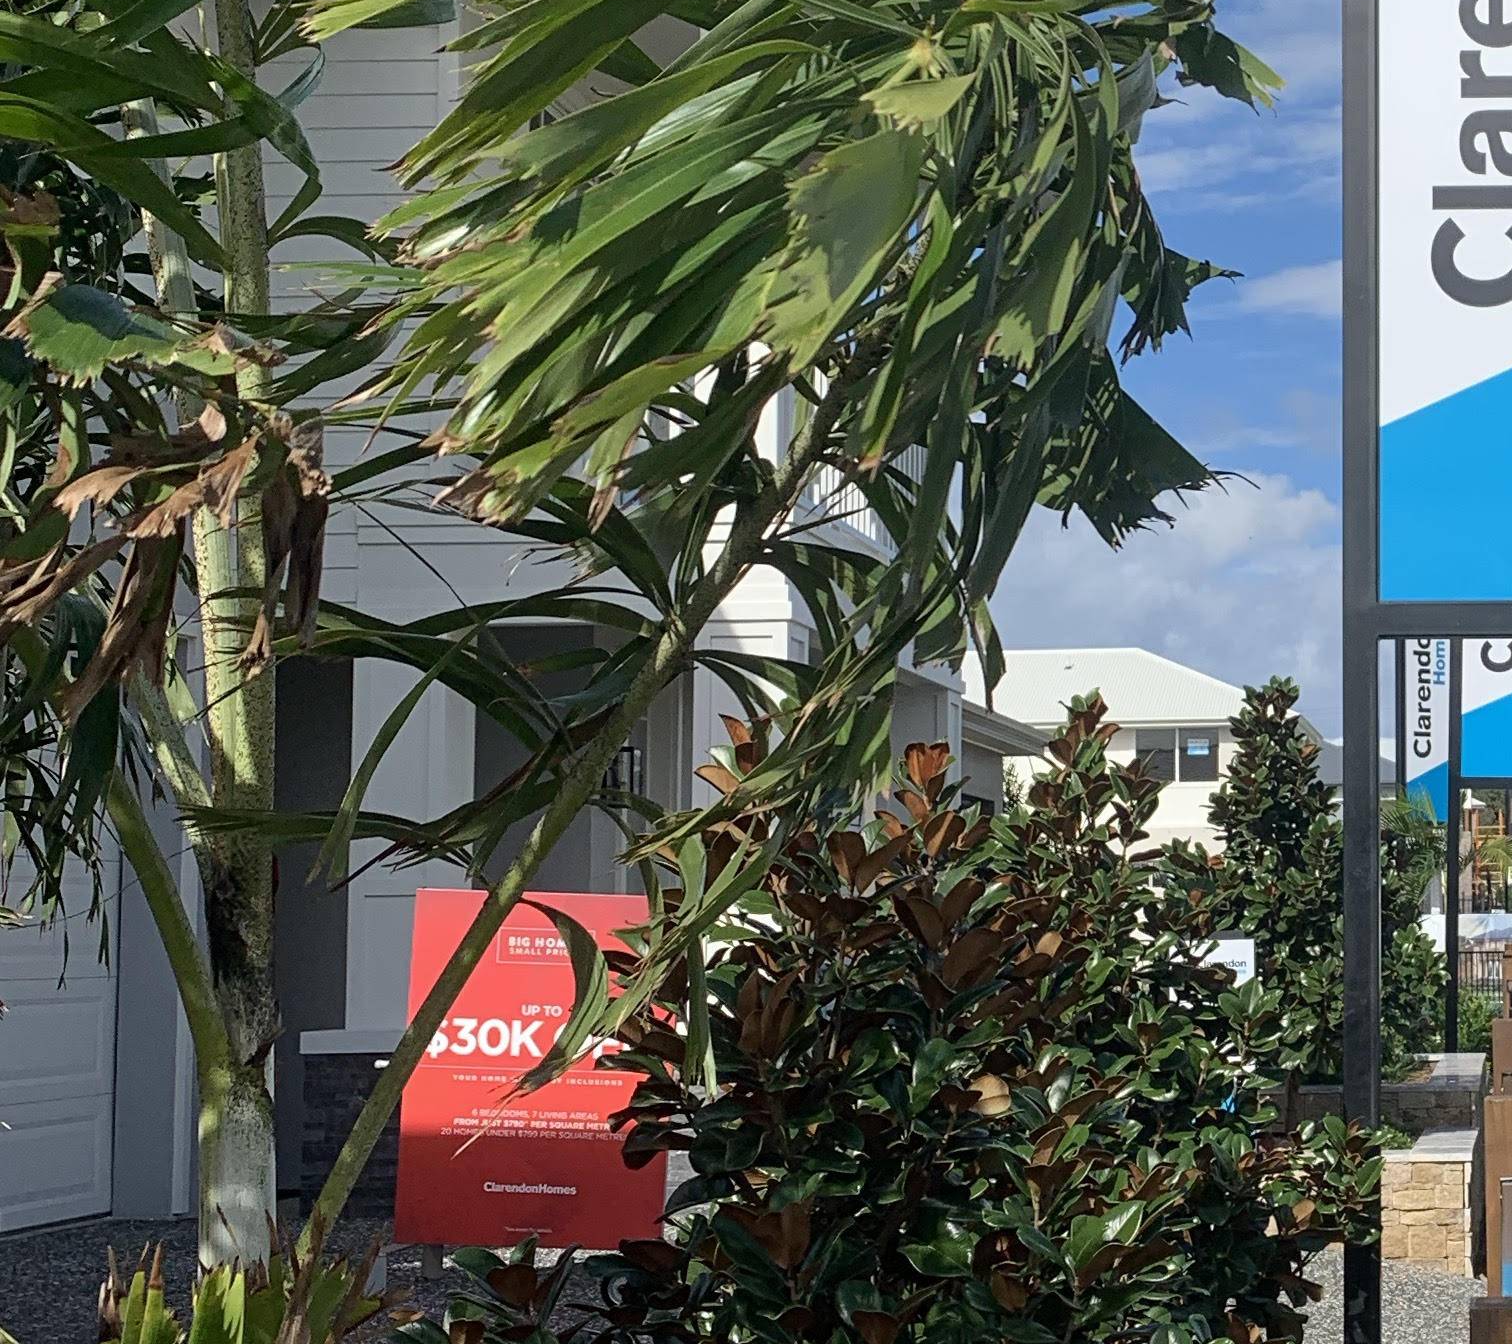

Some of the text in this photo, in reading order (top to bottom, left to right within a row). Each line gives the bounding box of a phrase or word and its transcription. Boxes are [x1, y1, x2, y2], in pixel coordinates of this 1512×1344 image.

[508, 936, 567, 947] BIG HOM
[509, 947, 570, 957] SMALL PRIC
[521, 1005, 563, 1017] UP TO
[426, 1017, 543, 1058] $30K
[453, 1118, 480, 1126] FROM
[549, 1121, 585, 1130] SQUARE
[587, 1123, 611, 1131] METR
